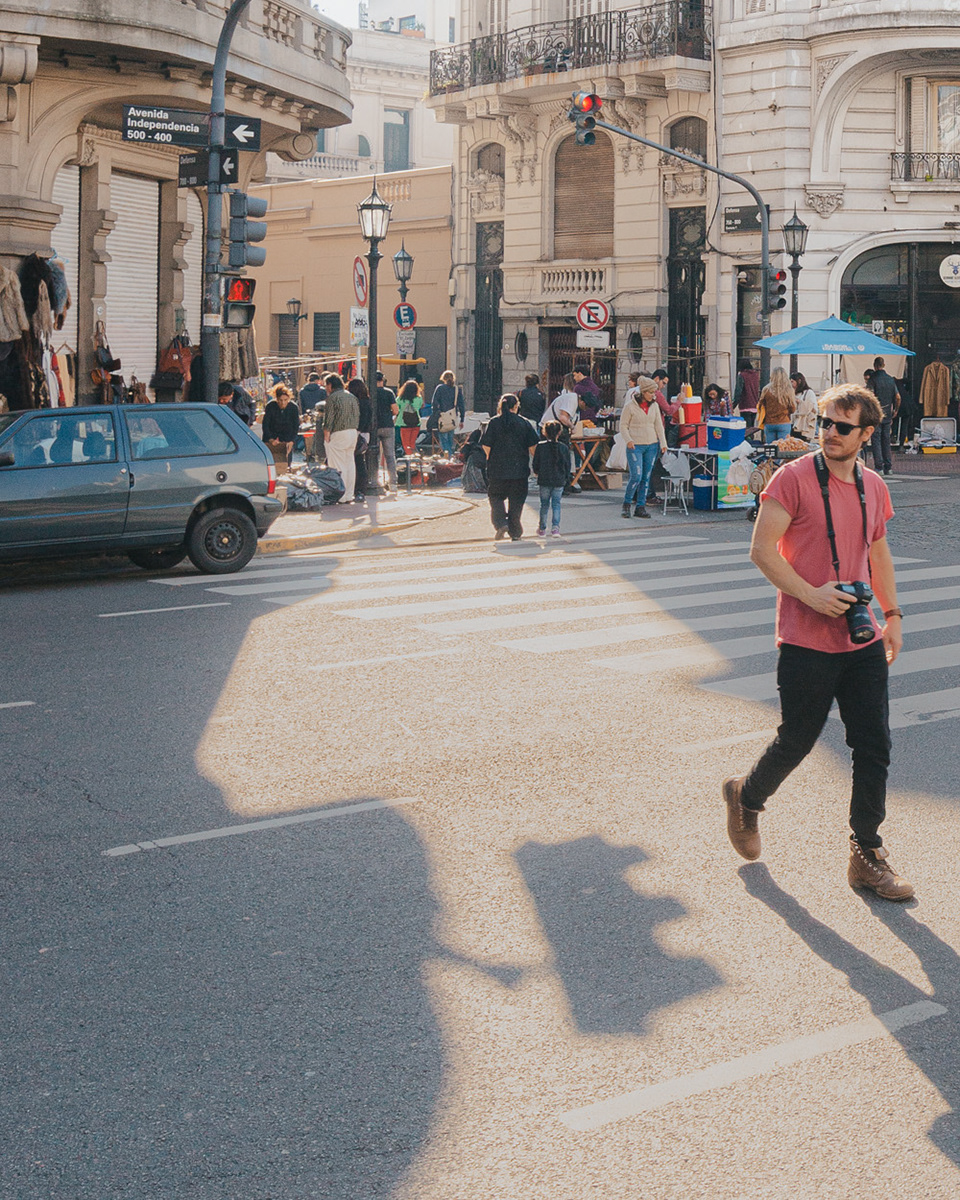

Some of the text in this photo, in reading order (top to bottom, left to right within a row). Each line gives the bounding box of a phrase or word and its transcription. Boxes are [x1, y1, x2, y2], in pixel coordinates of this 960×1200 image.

[128, 107, 169, 119] Avenida
[127, 118, 200, 133] Independencia
[127, 130, 146, 140] 500
[154, 132, 172, 142] 400
[400, 305, 410, 319] E
[587, 306, 600, 323] E
